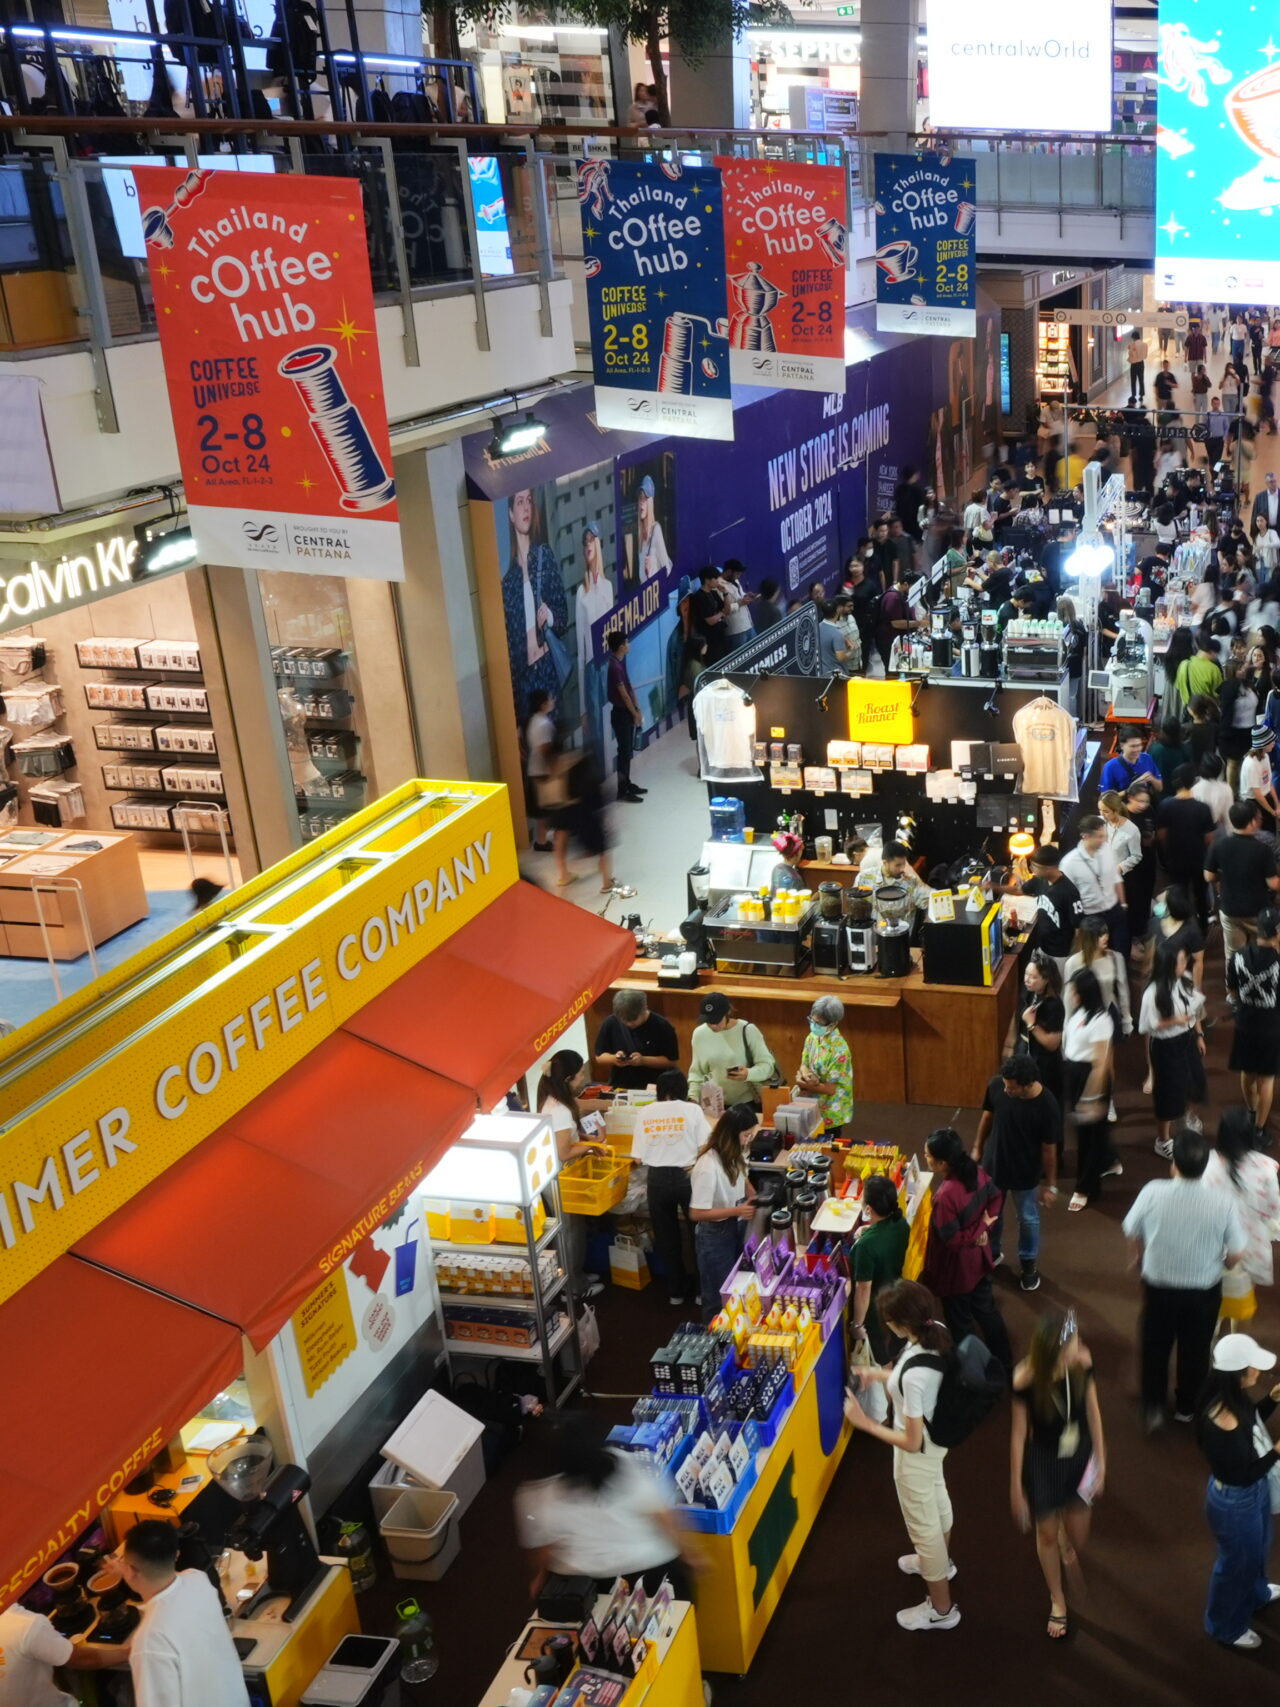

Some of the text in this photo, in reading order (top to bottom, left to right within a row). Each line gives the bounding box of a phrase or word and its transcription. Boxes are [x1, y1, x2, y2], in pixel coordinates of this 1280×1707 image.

[770, 40, 861, 64] SEPHO
[950, 38, 1091, 60] centralwOrld
[572, 144, 608, 153] BESHKA
[742, 180, 815, 208] Thailand
[893, 170, 950, 194] Thailand
[608, 185, 688, 220] Thailand
[891, 189, 959, 213] cOffee
[742, 204, 827, 235] cOffee
[909, 207, 949, 230] hub
[187, 206, 308, 258] Thailand
[608, 212, 701, 250] cOffee
[764, 228, 813, 256] hub
[936, 239, 969, 251] COFFEE
[634, 243, 688, 277] hub
[190, 247, 333, 303] cOffee
[792, 269, 833, 283] COFFEE
[936, 264, 969, 283] 2-8
[601, 285, 646, 303] COFFEE
[935, 282, 968, 293] Oct 24
[230, 293, 316, 343] hub
[602, 302, 646, 321] UNIVERSE
[791, 301, 832, 323] 2-8
[925, 315, 952, 323] CENTRAL
[603, 323, 649, 350] 2-8
[791, 325, 832, 337] Oct 24
[190, 357, 259, 382] COFFEE
[604, 352, 650, 366] Oct 24
[781, 365, 814, 375] CENTRAL
[193, 381, 261, 409] UNIVERSE
[823, 392, 844, 419] MLB
[661, 407, 697, 418] CENTRAL
[197, 413, 267, 451] 2-8
[202, 454, 270, 474] Oct 24
[767, 403, 890, 512] NEW STORE IS COMING
[780, 502, 813, 554] OCTOBER
[814, 490, 832, 531] 2024
[294, 535, 350, 549] CENTRAL
[296, 547, 351, 560] PATTANA
[856, 711, 897, 725] Runner
[864, 702, 899, 714] Roast
[1072, 900, 1084, 915] 13
[154, 956, 329, 1120] COFFEE
[336, 831, 495, 982] COMPANY
[319, 1198, 388, 1274] SIGNATURE
[301, 1288, 338, 1328] SIGNATURE
[0, 1426, 163, 1606] PECIALTY COFFEE
